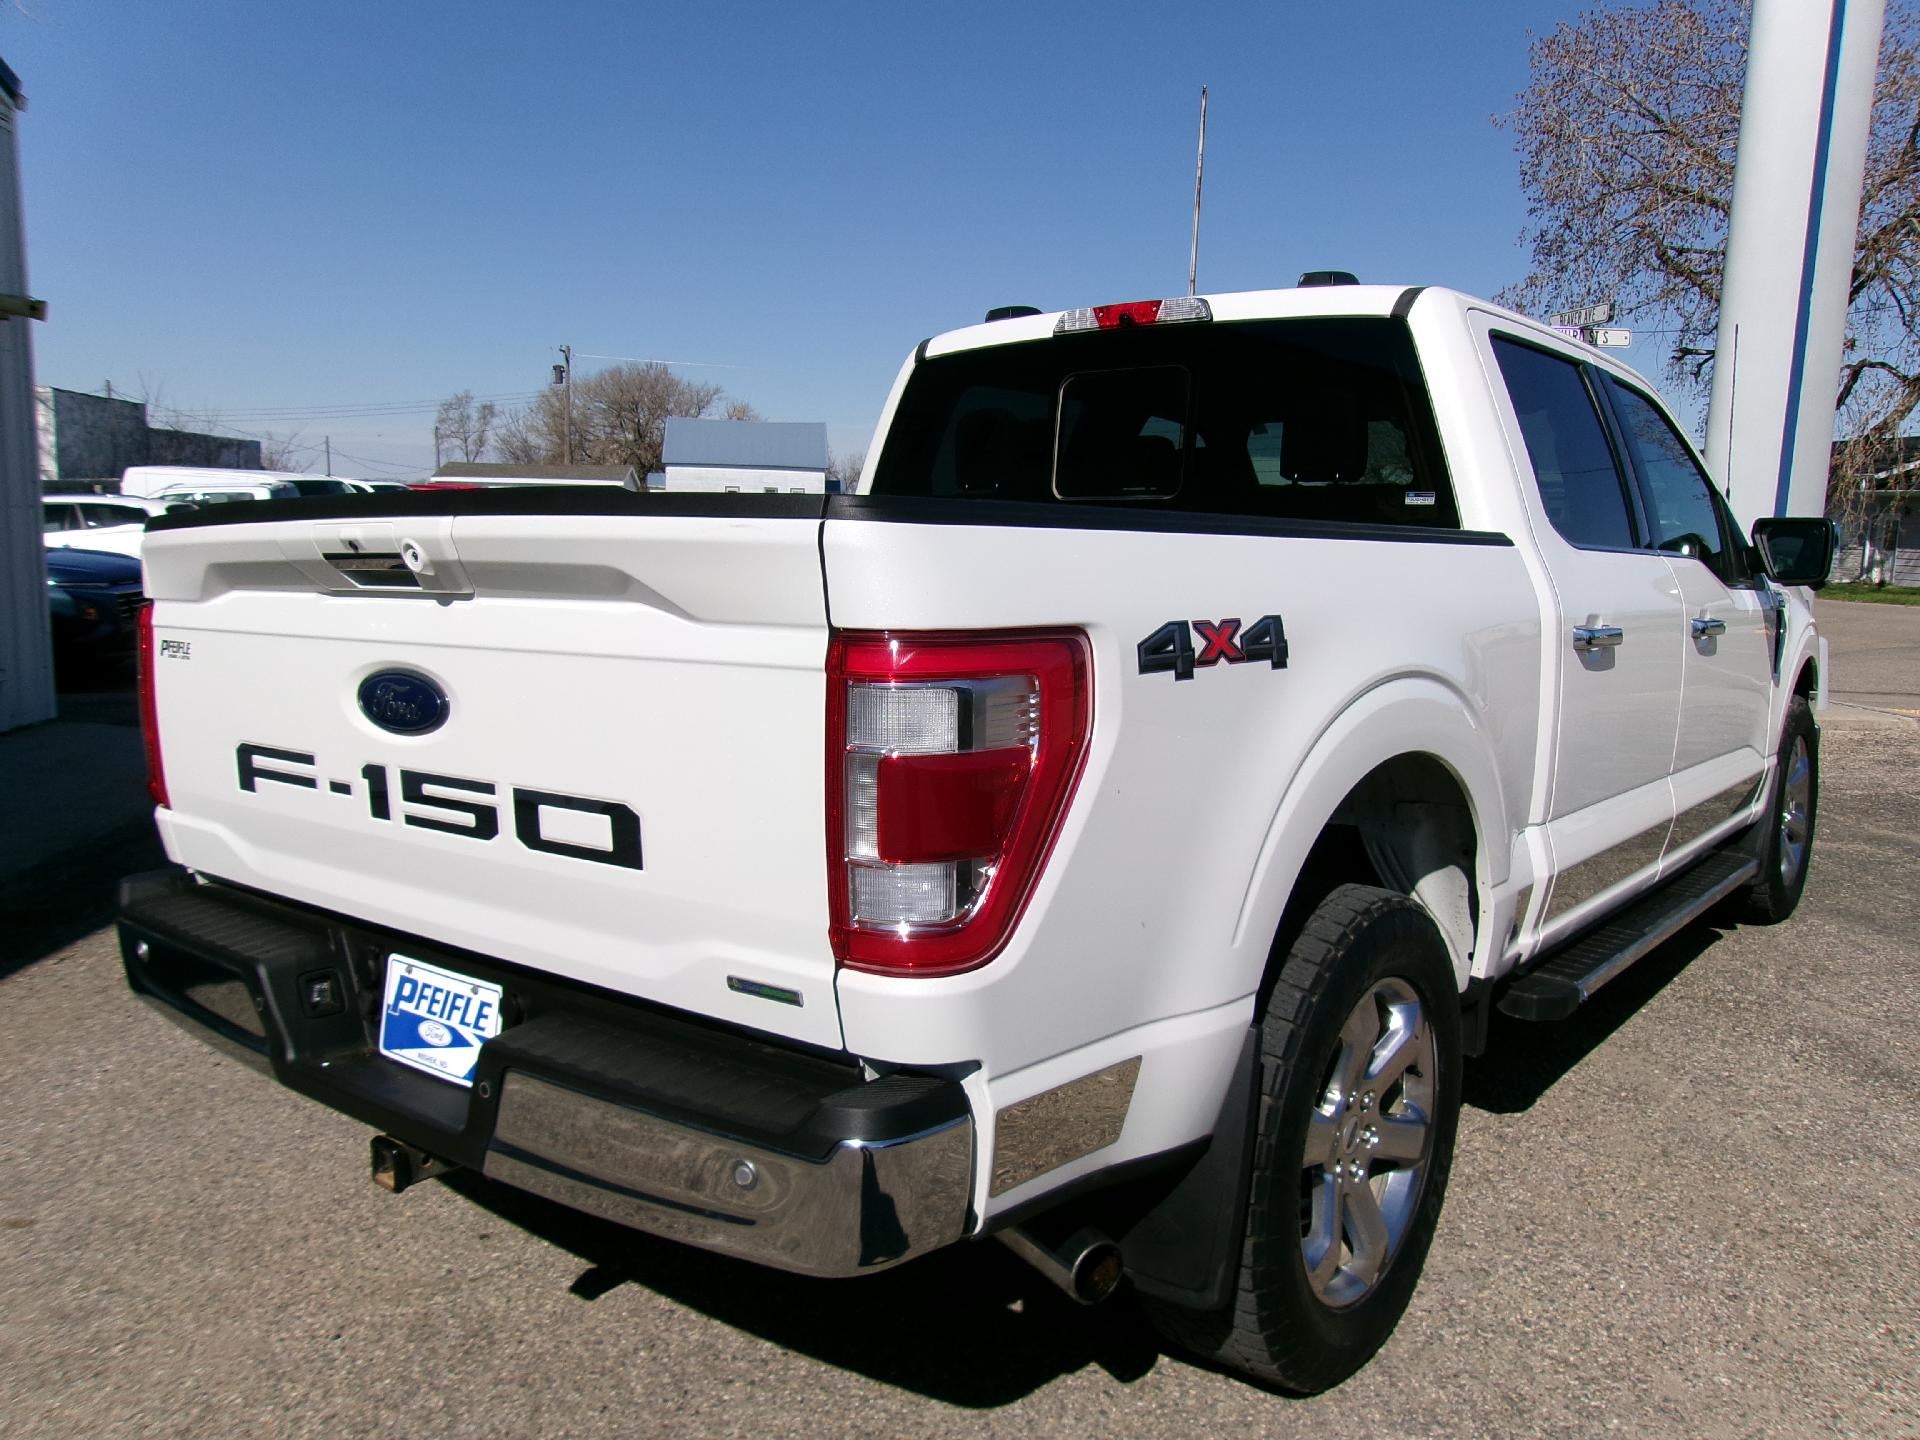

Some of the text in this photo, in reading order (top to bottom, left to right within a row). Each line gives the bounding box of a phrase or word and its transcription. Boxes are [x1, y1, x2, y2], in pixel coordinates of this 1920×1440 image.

[1559, 307, 1596, 327] BEAVER AVE
[1588, 331, 1599, 345] ST
[1602, 330, 1609, 344] S
[372, 681, 423, 721] Ford
[236, 742, 644, 871] F-150
[388, 974, 493, 1032] PFEIFLE
